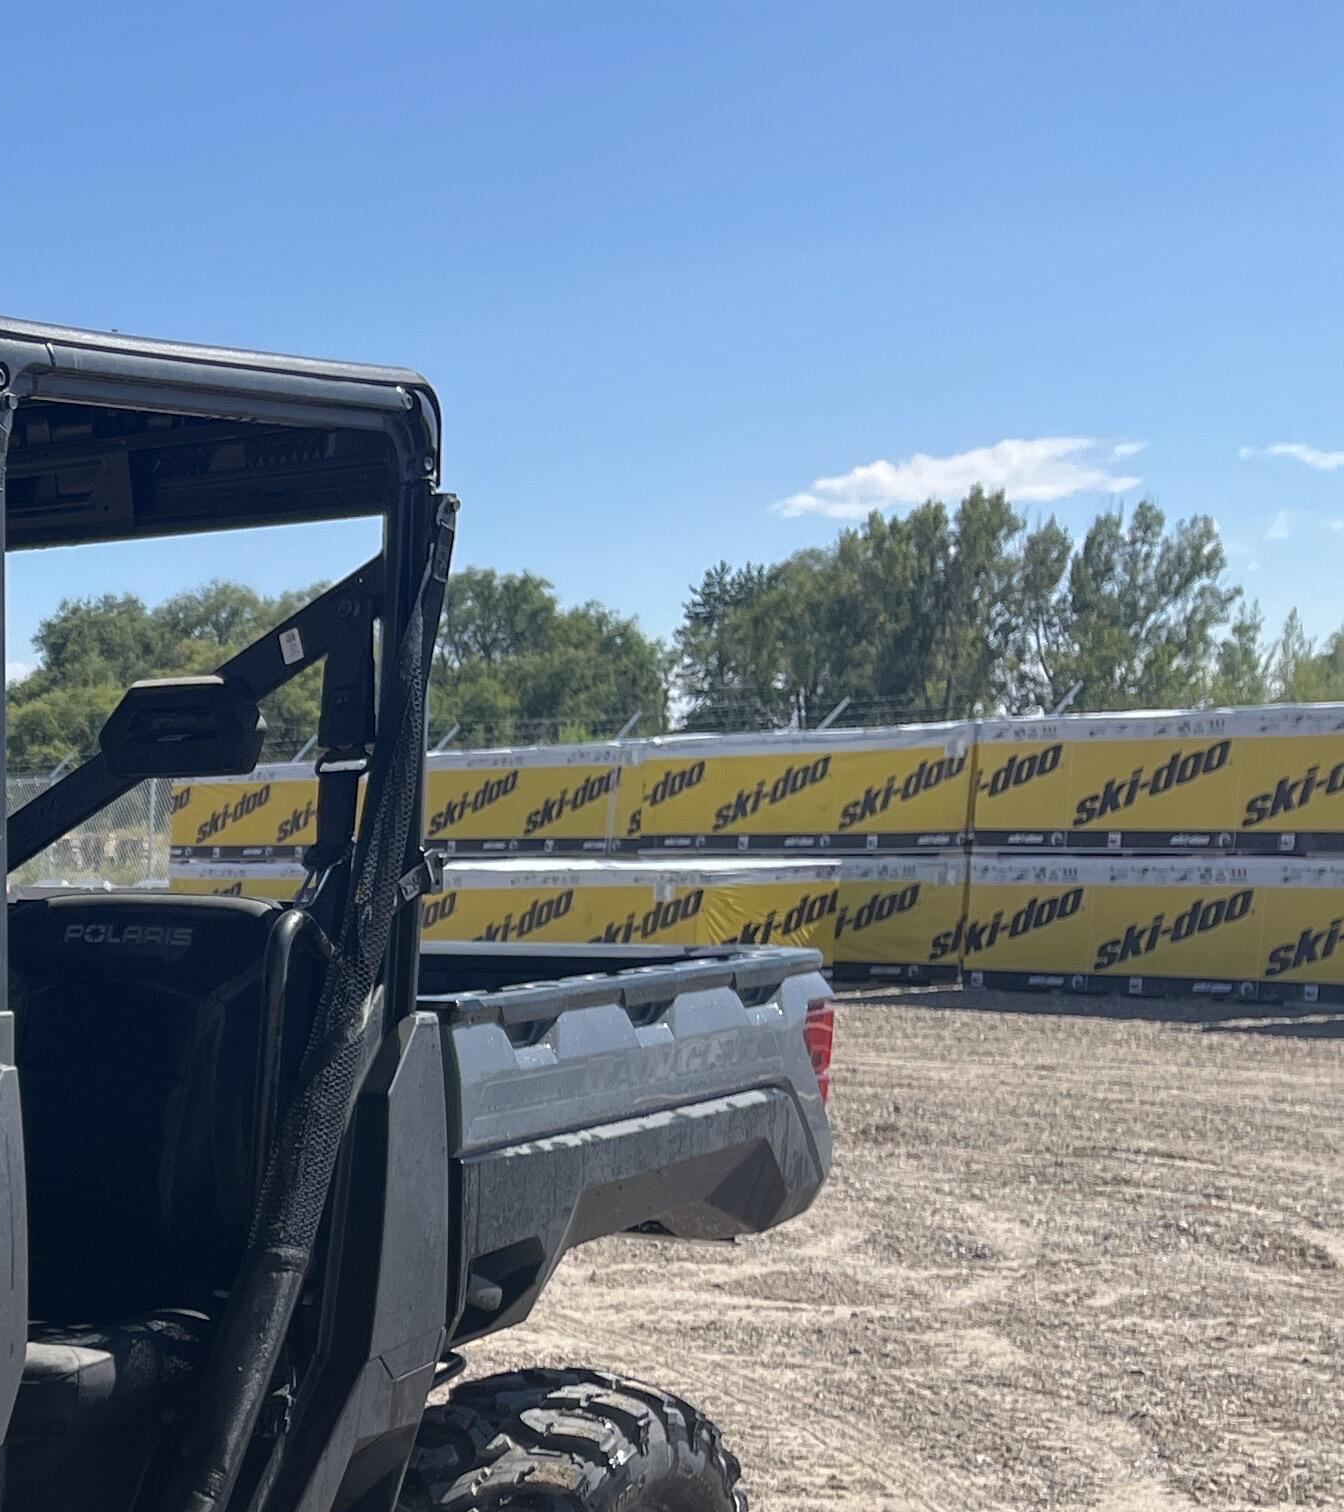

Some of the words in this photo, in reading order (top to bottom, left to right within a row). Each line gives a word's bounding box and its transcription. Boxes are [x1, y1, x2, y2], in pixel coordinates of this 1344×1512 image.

[196, 783, 271, 844] ski-doo
[427, 768, 519, 837] ski-doo
[523, 765, 622, 837] ski-doo
[713, 753, 833, 832] ski-doo
[838, 748, 969, 832] ski-doo
[1073, 739, 1233, 828] ski-doo
[276, 800, 318, 844] ski-
[64, 923, 193, 947] POLARIS
[472, 888, 575, 943] ki-doo
[587, 889, 705, 944] ki-doo
[835, 883, 922, 940] i-doo
[965, 887, 1085, 956] ki-doo
[1094, 887, 1255, 972] ski-doo
[1265, 917, 1344, 977] ski-
